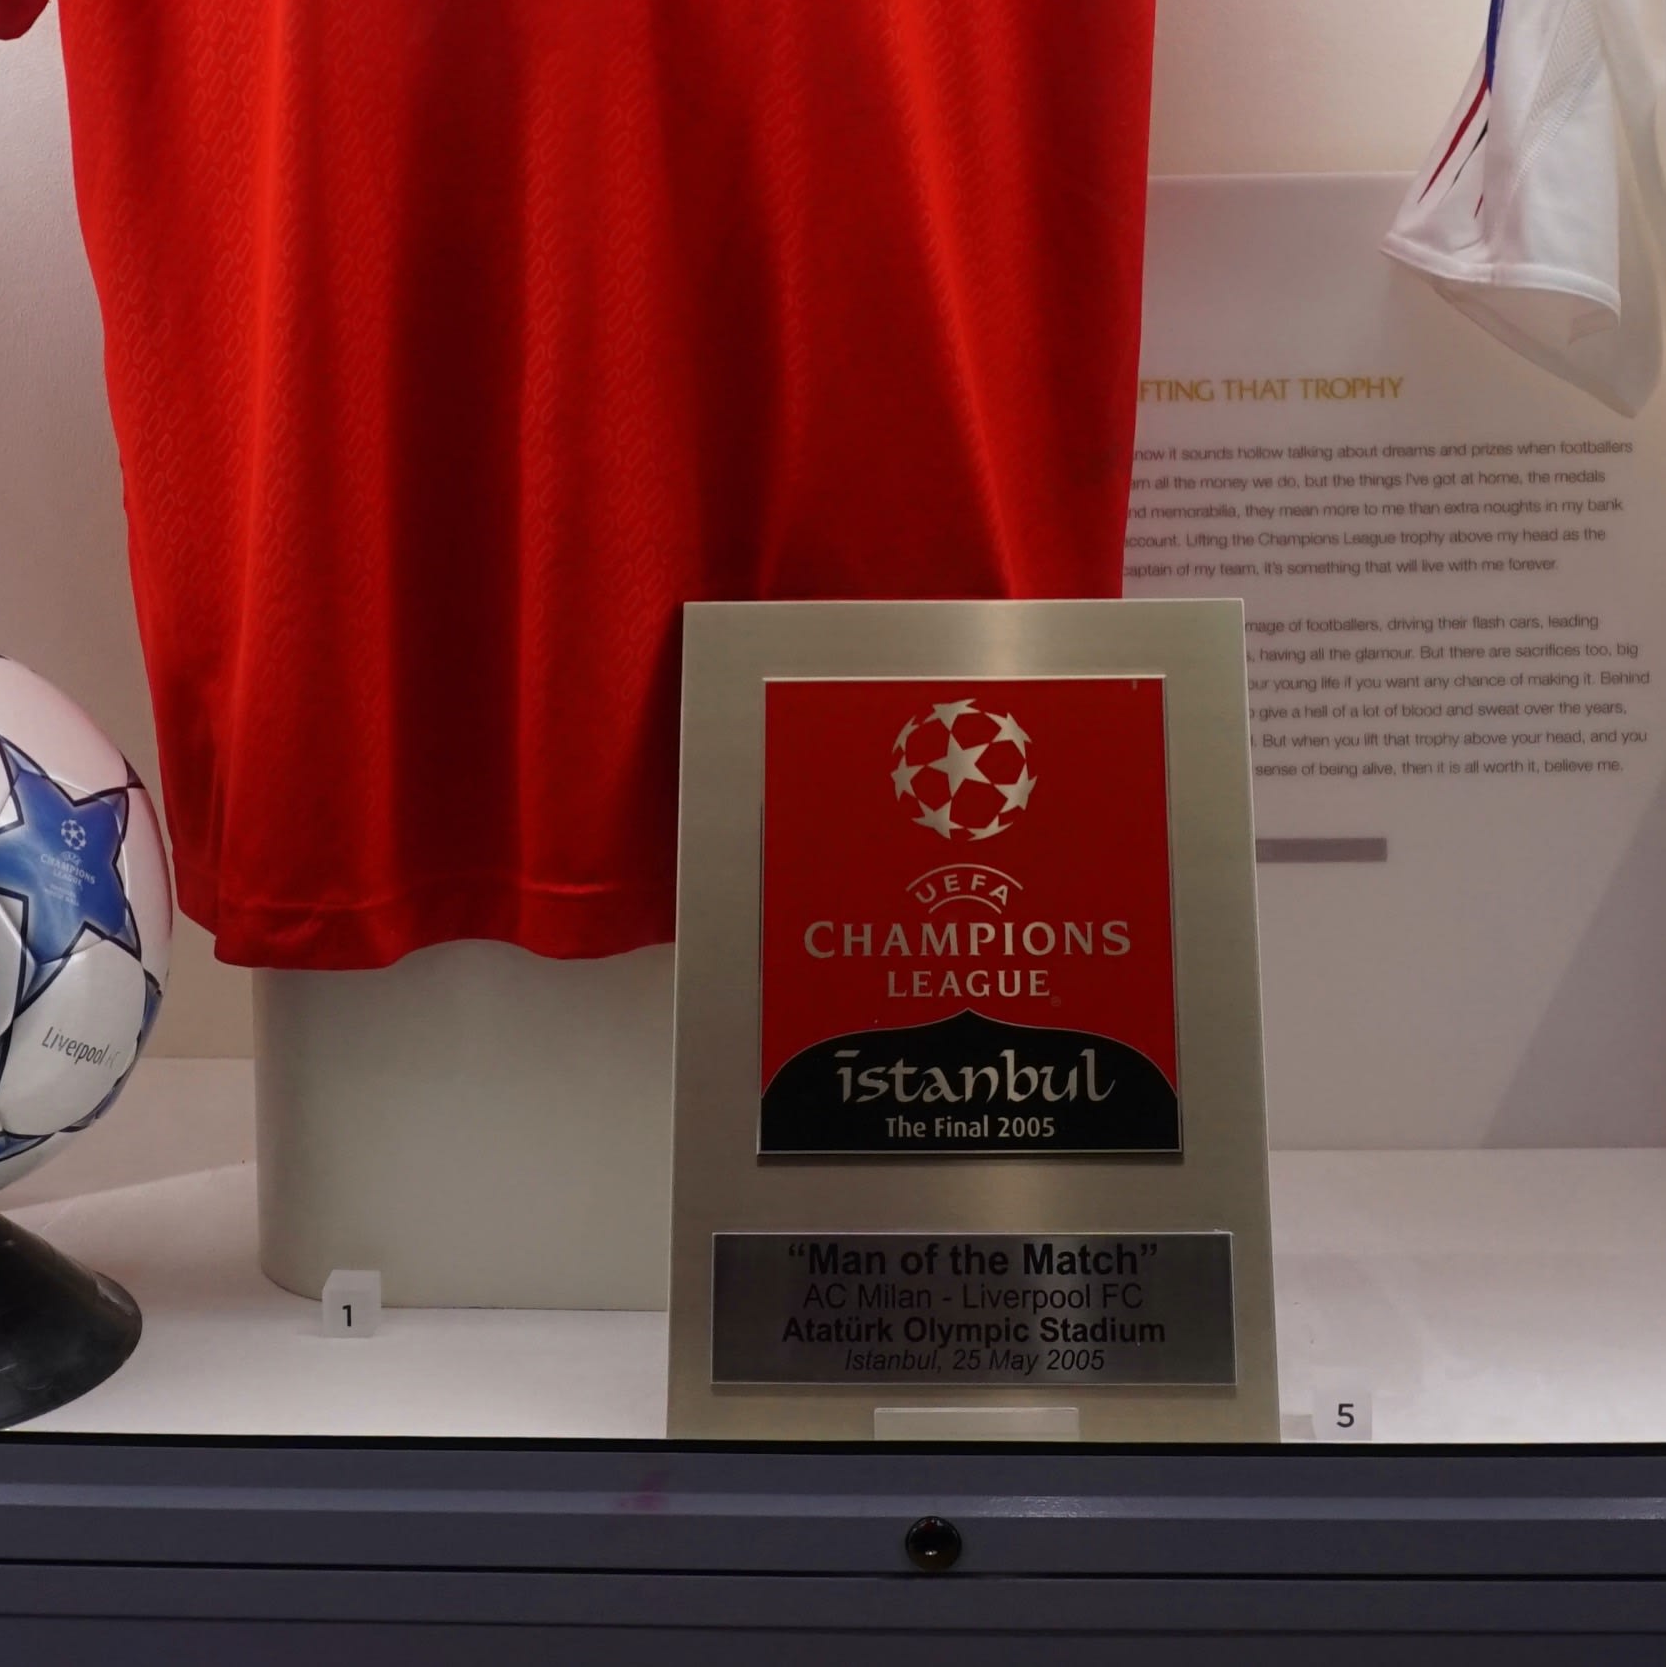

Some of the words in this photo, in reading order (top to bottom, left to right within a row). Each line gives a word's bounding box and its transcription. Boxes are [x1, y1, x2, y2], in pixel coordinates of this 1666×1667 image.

[1222, 378, 1290, 401] THAT
[1299, 376, 1404, 400] TROPHY
[1254, 764, 1298, 777] sense
[1300, 762, 1316, 777] of
[1318, 761, 1359, 779] being
[1400, 760, 1434, 775] then
[1436, 760, 1445, 775] it
[1448, 760, 1462, 775] is
[1463, 760, 1480, 775] all
[1482, 759, 1525, 775] worth
[1543, 759, 1594, 775] believe
[913, 873, 1010, 906] UEFA
[804, 920, 1131, 959] CHAMPIONS
[888, 969, 1050, 998] LEAGUE
[41, 1026, 111, 1067] Liverpool
[885, 1114, 927, 1138] The
[934, 1114, 989, 1138] Final
[997, 1116, 1055, 1138] 2005
[900, 1243, 938, 1275] of
[949, 1244, 1009, 1275] the
[804, 1283, 846, 1308] AC
[858, 1284, 931, 1309] Milan
[963, 1283, 1091, 1315] Liverpool
[1102, 1283, 1143, 1309] FC
[342, 1304, 352, 1328] 1
[782, 1317, 892, 1343] Atatürk
[904, 1316, 1030, 1348] Olympic
[1039, 1316, 1165, 1343] Stadium
[846, 1349, 942, 1371] Istanbul,
[952, 1349, 981, 1371] 25
[988, 1349, 1040, 1376] May
[1046, 1348, 1105, 1371] 2005
[1336, 1402, 1355, 1429] 5
